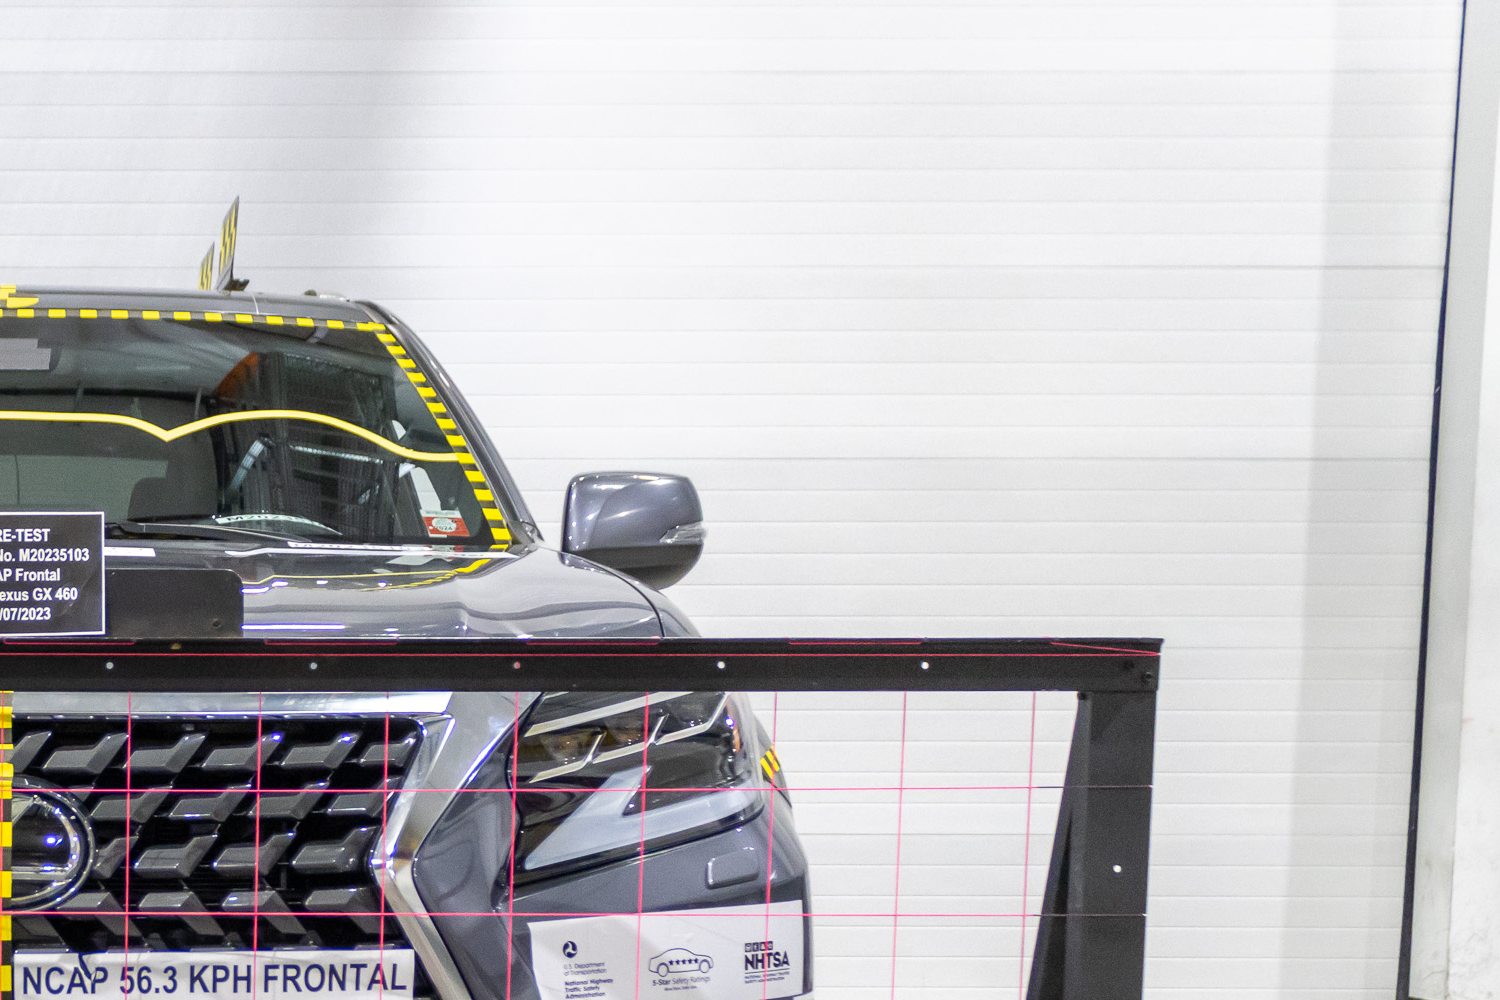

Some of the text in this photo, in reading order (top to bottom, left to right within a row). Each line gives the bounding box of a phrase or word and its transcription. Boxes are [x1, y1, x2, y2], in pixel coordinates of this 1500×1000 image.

[19, 548, 90, 562] M20235103
[15, 567, 61, 582] Frontal
[32, 587, 53, 601] GX
[55, 587, 78, 601] 460
[744, 950, 790, 971] NHTSA
[22, 963, 408, 995] NCAP 56.3 KPH FRONTAL
